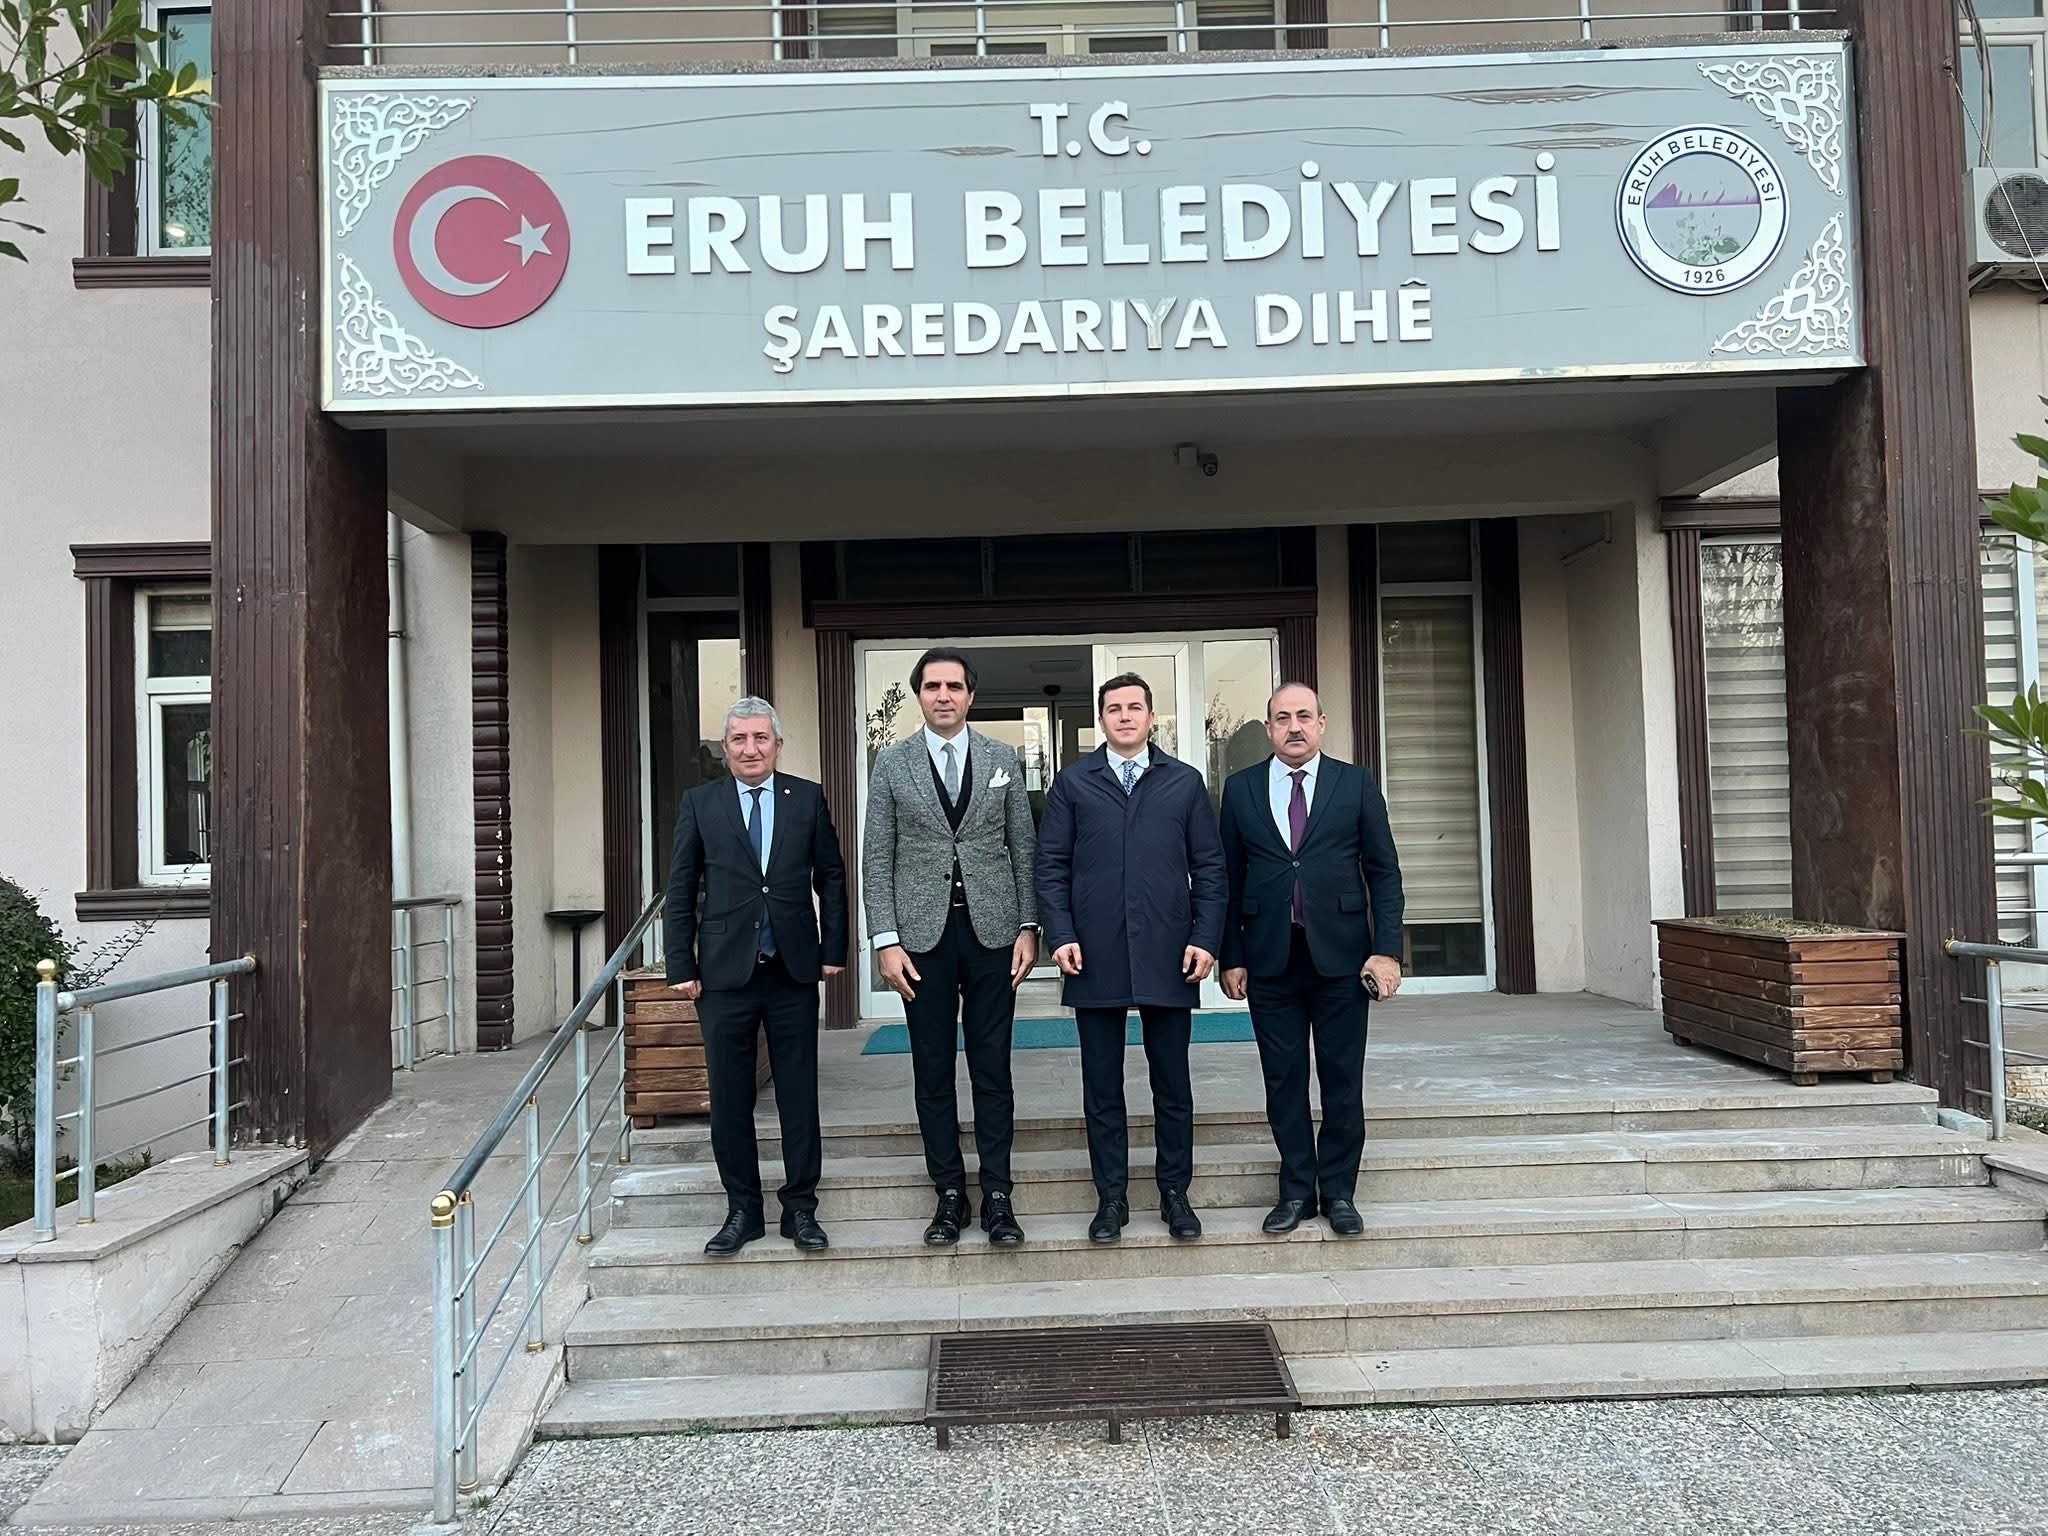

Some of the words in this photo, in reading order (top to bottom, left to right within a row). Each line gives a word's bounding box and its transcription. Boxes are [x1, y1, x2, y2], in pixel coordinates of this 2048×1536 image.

[1030, 100, 1152, 156] T.C.
[1628, 151, 1664, 206] ERUH
[1668, 135, 1780, 202] BELEDİYESİ
[625, 192, 914, 274] ERUH
[964, 152, 1561, 268] BELEDİYESİ
[1683, 269, 1726, 284] 1926
[763, 297, 1227, 374] ŞAREDARIYA
[1254, 277, 1433, 346] DIHÊ
